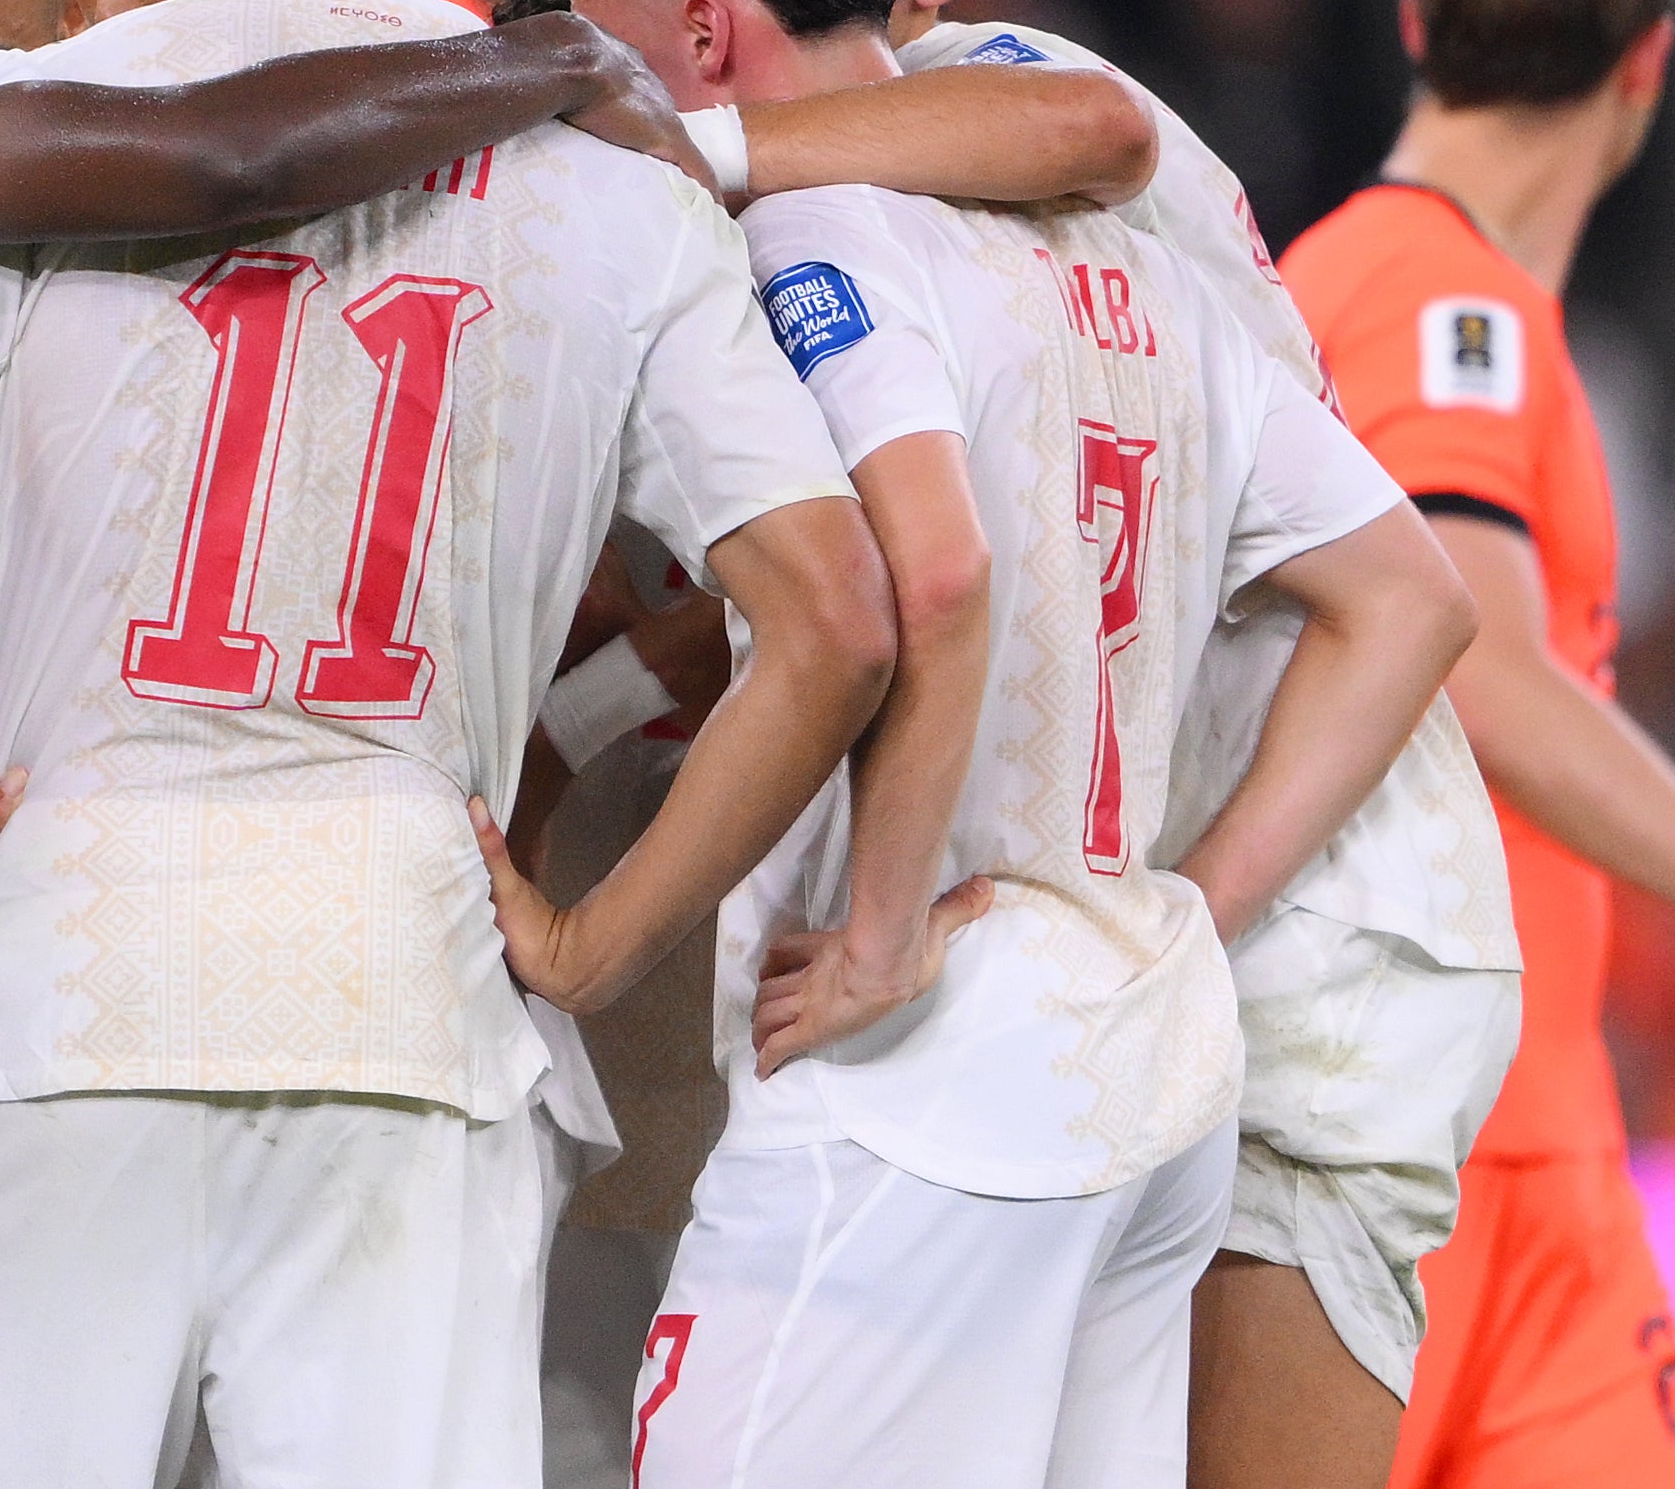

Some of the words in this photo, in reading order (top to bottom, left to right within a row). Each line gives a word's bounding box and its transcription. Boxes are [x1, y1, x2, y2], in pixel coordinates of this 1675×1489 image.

[768, 275, 832, 317] FOOTBALL
[775, 289, 840, 335] UNITES
[801, 305, 850, 337] World
[803, 331, 833, 352] FIFA
[120, 249, 494, 721] 11
[1078, 417, 1160, 877] 7
